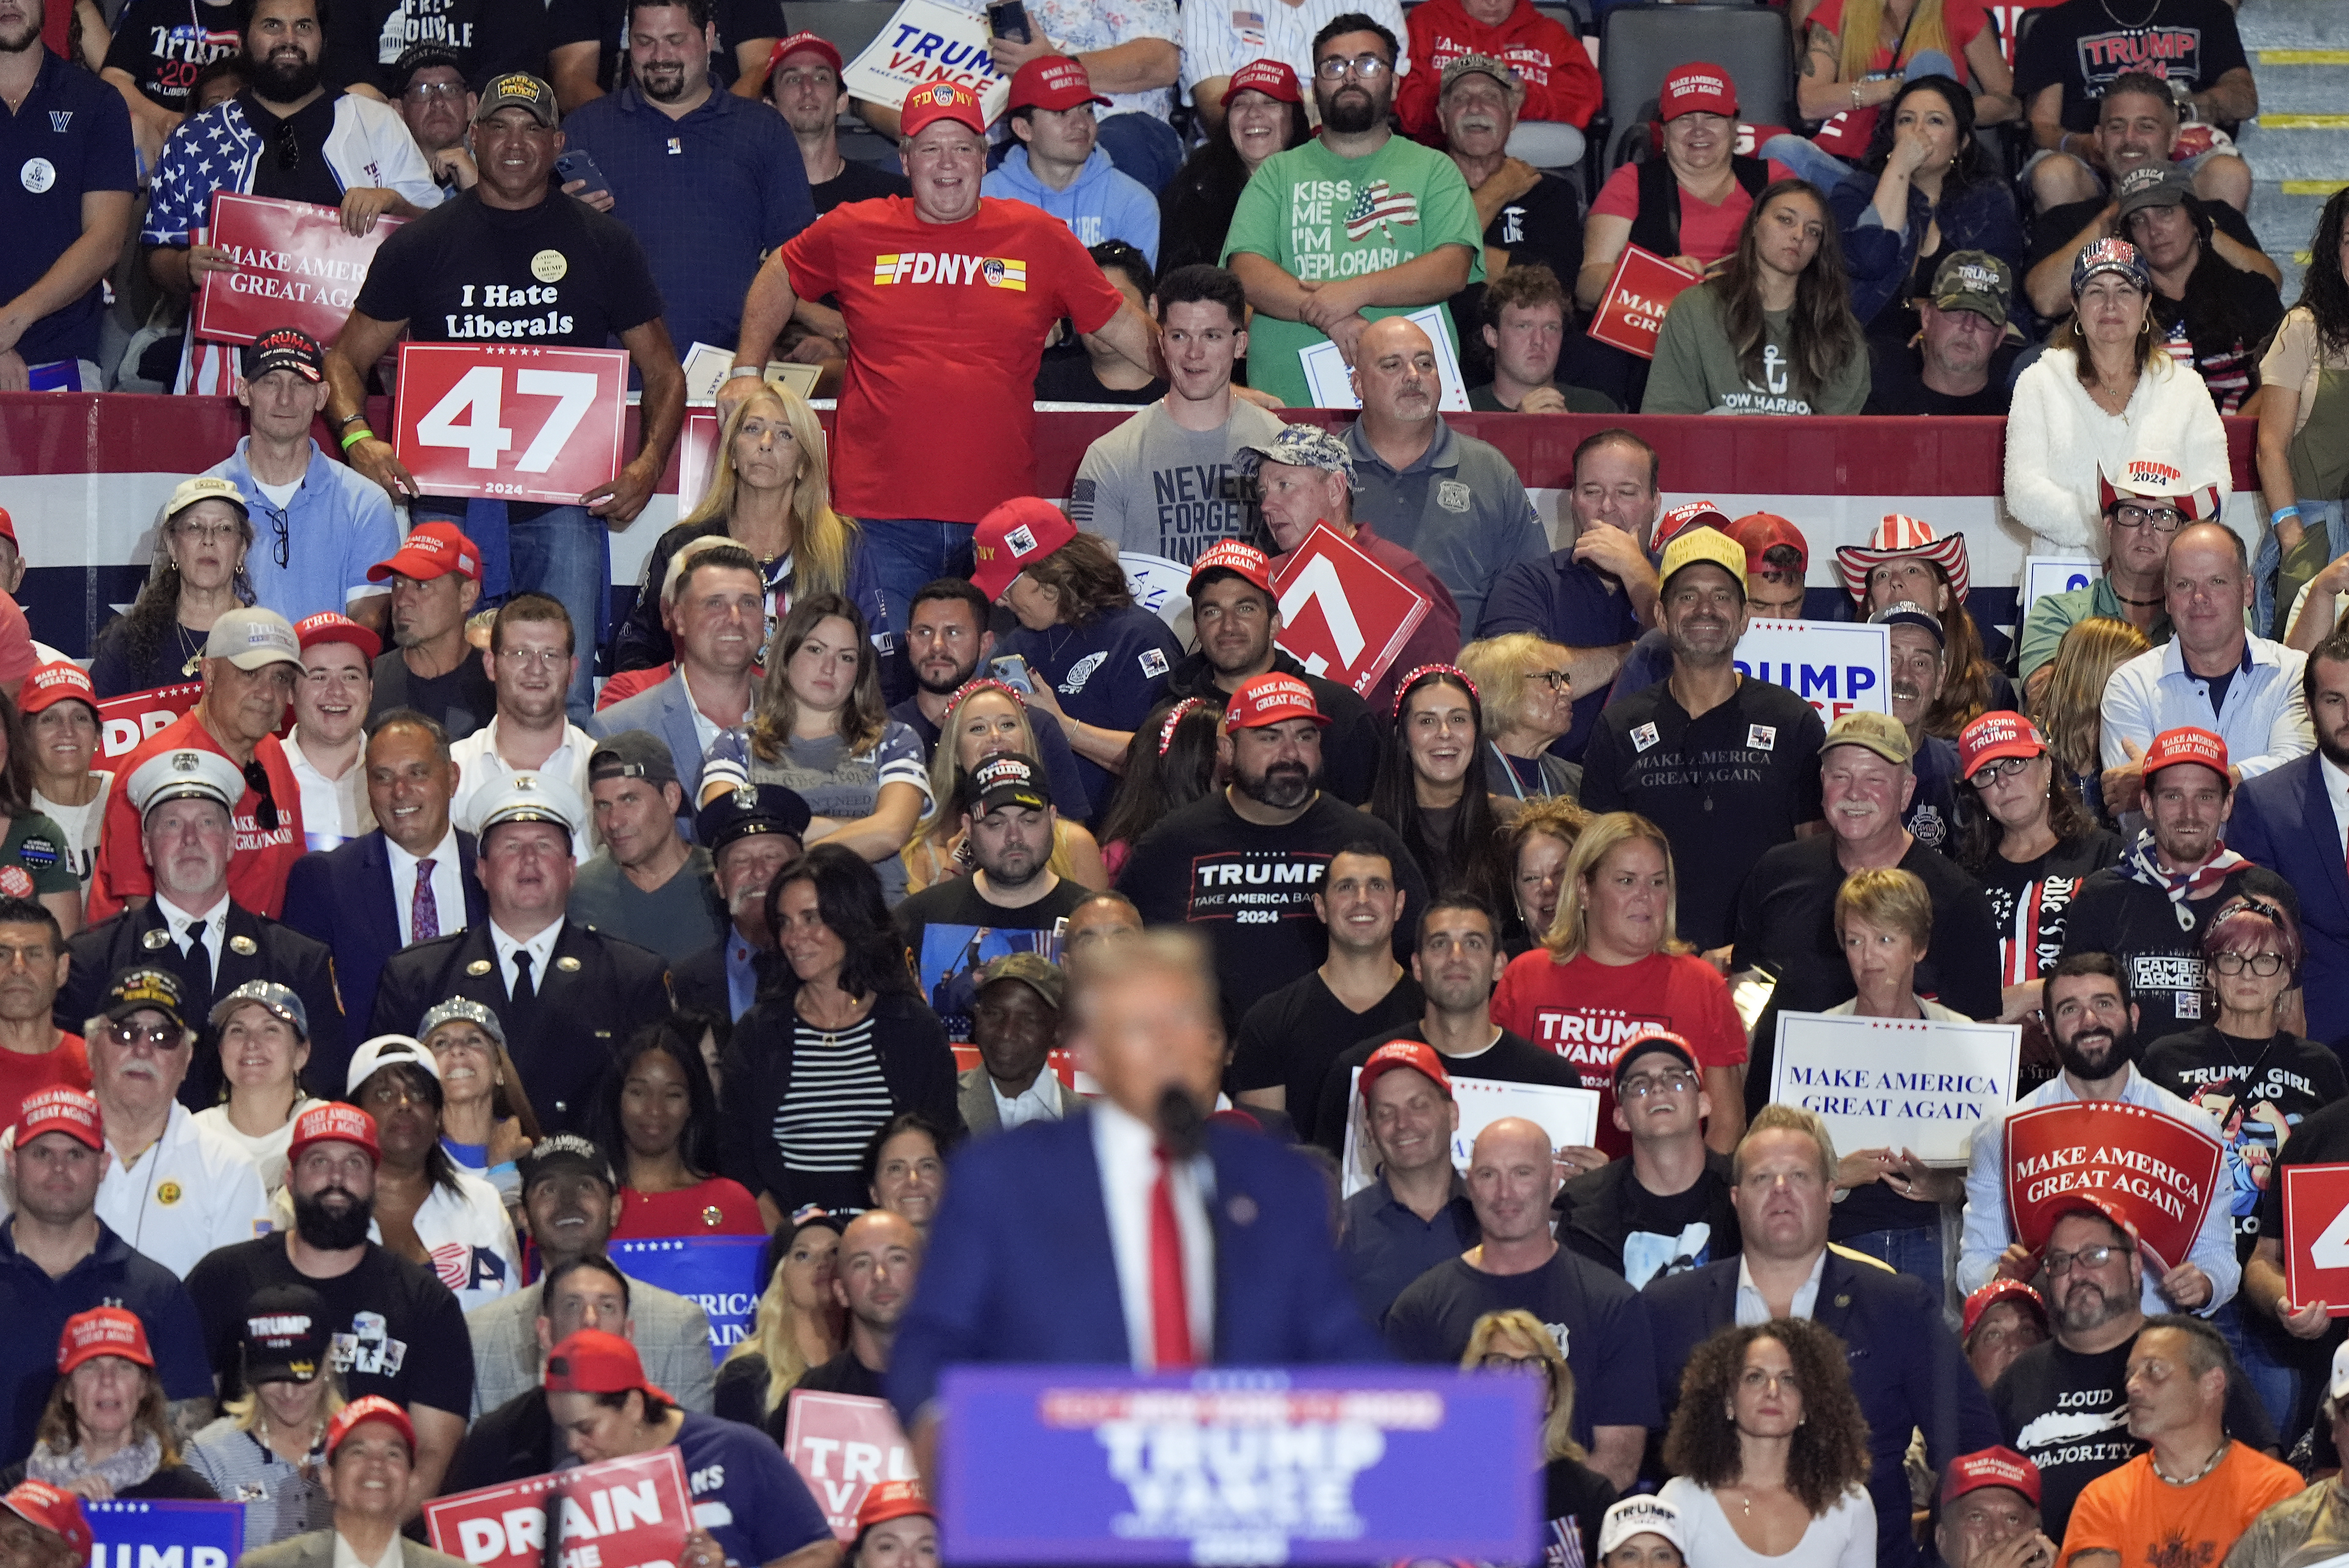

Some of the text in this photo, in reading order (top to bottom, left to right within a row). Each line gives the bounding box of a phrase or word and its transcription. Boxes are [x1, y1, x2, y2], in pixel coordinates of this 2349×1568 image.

[892, 23, 1005, 79] TRUM
[2085, 32, 2194, 65] TRUMP
[161, 59, 198, 87] 20
[1251, 62, 1285, 77] AMERICA
[1255, 72, 1280, 86] AGAIN
[1670, 75, 1724, 90] MAKE AMERICA
[1674, 83, 1722, 99] GREAT AGAIN
[912, 89, 973, 108] FD NY
[1293, 180, 1352, 202] KISS
[1291, 200, 1332, 227] ME
[1291, 226, 1332, 253] I'M
[220, 242, 366, 281] MAKE AMER
[892, 252, 984, 286] FDNY
[1957, 266, 2000, 284] TRUMP
[230, 272, 360, 310] GREAT AGA
[461, 285, 558, 307] I Hate
[1617, 288, 1667, 318] MAK
[445, 310, 574, 338] Liberals
[259, 333, 313, 352] TRUMP
[1721, 393, 1751, 407] OW
[416, 365, 599, 474] 47
[2128, 461, 2181, 480] TRUMP
[2132, 472, 2167, 486] 2024
[485, 481, 524, 495] 2024
[1153, 464, 1259, 504] NEVER
[1157, 501, 1256, 535] FORGET
[1668, 503, 1698, 517] MAKE
[978, 546, 995, 561] NY
[1195, 543, 1255, 564] MAKE AMERICA
[1223, 554, 1248, 572] AGAIN
[34, 667, 91, 688] MAKE AMERICA
[39, 674, 90, 692] GREAT AGAIN
[1247, 680, 1314, 701] MAKE AMERICA
[1256, 694, 1288, 712] GREAT
[1965, 718, 2017, 740] NEW YORK
[1982, 726, 2000, 735] FOR
[1969, 730, 2017, 753] TRUMP
[2161, 732, 2221, 751] MAKE AMERICA
[2164, 743, 2218, 760] GREAT AGAIN
[1635, 752, 1685, 770] MAKE
[976, 764, 1031, 785] Trump
[1640, 768, 1762, 787] GREAT AGAIN
[1194, 891, 1318, 908] TAKE AMERICA BAC
[1236, 910, 1279, 924] 2024
[2139, 971, 2205, 987] ARMOR
[1554, 1042, 1623, 1066] VANC
[1580, 1075, 1610, 1088] 2024
[1789, 1066, 1870, 1090] MAKE
[1875, 1069, 1998, 1096] AMERICA
[2267, 1067, 2316, 1097] GIRL
[1802, 1094, 1983, 1121] GREAT AGAIN
[2017, 1146, 2200, 1206] MAKE AMERICA
[2027, 1169, 2186, 1223] GREAT AGAIN
[247, 1314, 312, 1337] TRUMP
[2057, 1389, 2113, 1407] LOUD
[1964, 1457, 2026, 1477] MAKE AMERICA
[1968, 1466, 2023, 1482] GREAT AGAIN
[457, 1479, 663, 1565] DRAIN
[1614, 1502, 1677, 1522] TRUMP
